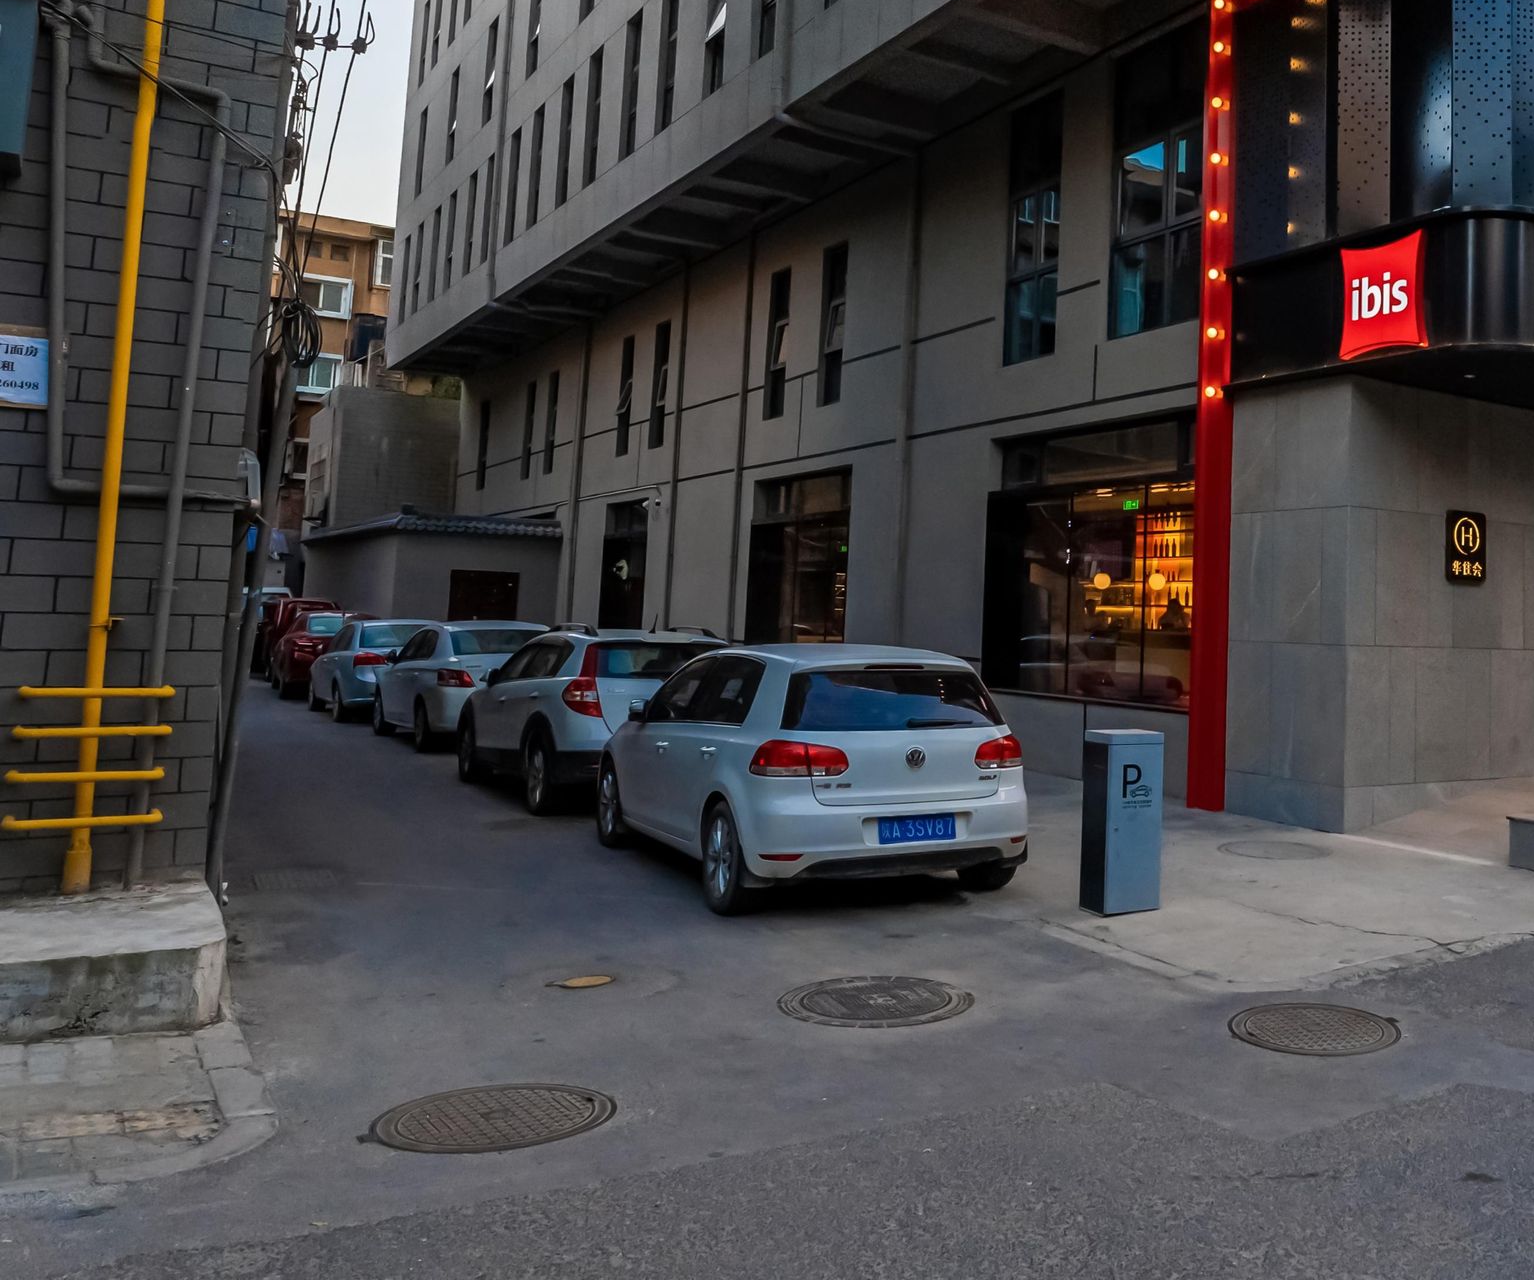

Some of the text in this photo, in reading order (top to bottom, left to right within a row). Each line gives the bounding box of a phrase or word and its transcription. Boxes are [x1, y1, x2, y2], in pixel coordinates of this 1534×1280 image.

[1351, 271, 1409, 321] ibis
[1452, 560, 1483, 578] 华住会
[1122, 764, 1143, 799] P
